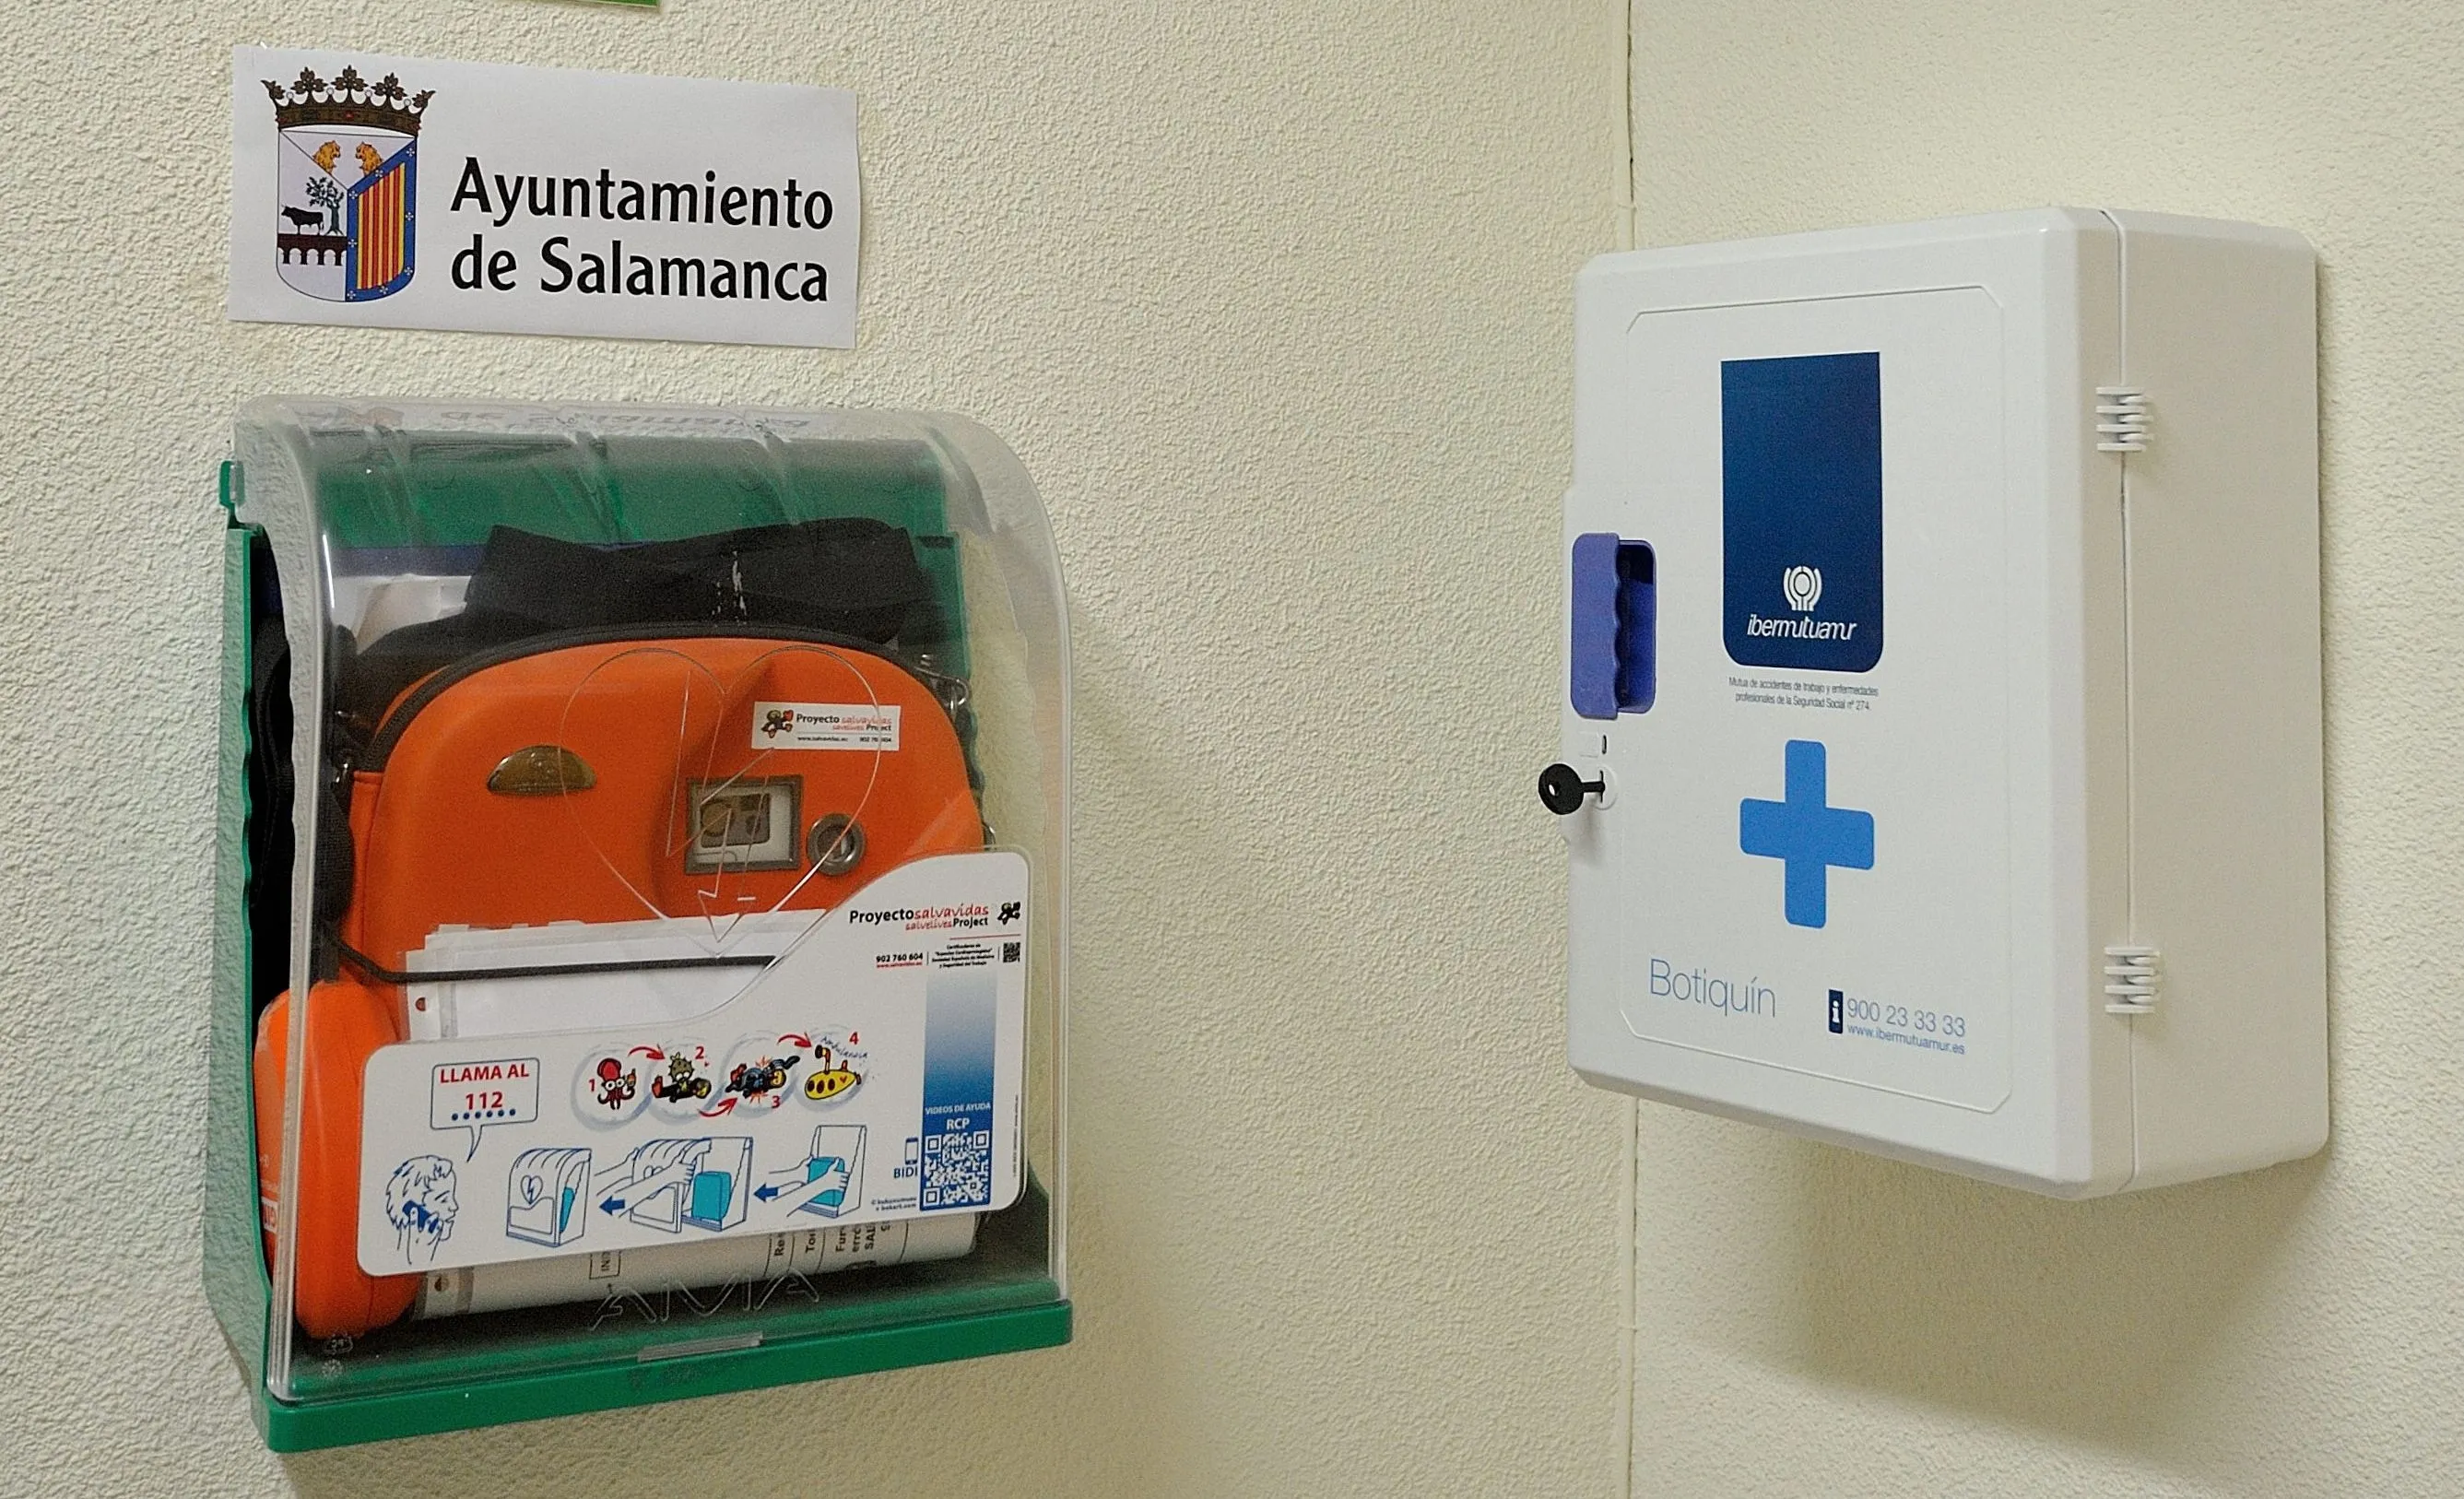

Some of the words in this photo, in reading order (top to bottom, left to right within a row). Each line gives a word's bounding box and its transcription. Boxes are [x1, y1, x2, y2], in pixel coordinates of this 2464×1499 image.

[450, 156, 833, 230] Ayuntamiento
[451, 233, 517, 290] de
[540, 236, 829, 302] Salamanca
[1746, 613, 1857, 641] ibermutuamur
[1728, 676, 1749, 688] Mutua
[1750, 678, 1759, 688] de
[1759, 679, 1793, 690] accidentes
[1793, 681, 1802, 691] de
[1802, 681, 1824, 693] trabajo
[1832, 684, 1880, 697] enfermedades
[1735, 691, 1775, 704] profesionales
[1776, 693, 1786, 704] de
[1786, 694, 1793, 705] la
[1793, 696, 1825, 709] Seguridad
[1826, 698, 1845, 710] Social
[796, 713, 840, 725] Proyecto
[866, 723, 892, 732] Proect
[876, 954, 890, 962] 902
[892, 953, 907, 962] 760
[908, 952, 924, 961] 604
[1649, 958, 1775, 1019] Botiquín
[1846, 998, 1880, 1022] 900
[1886, 1005, 1908, 1027] 23
[1914, 1009, 1937, 1033] 33
[1942, 1015, 1965, 1038] 33
[849, 1032, 859, 1045] 4
[1846, 1023, 1965, 1055] www.ibermutuamur.es
[694, 1045, 704, 1060] 2
[440, 1064, 502, 1083] LLAMA
[507, 1063, 530, 1080] AL
[588, 1078, 595, 1092] 1
[466, 1091, 503, 1110] 112
[771, 1095, 781, 1109] 3
[925, 1105, 953, 1115] VIDEOS
[954, 1104, 964, 1113] DE
[965, 1102, 991, 1112] AYUDA
[946, 1116, 971, 1131] RCP
[893, 1165, 918, 1179] BIDI
[864, 1223, 876, 1250] SAL
